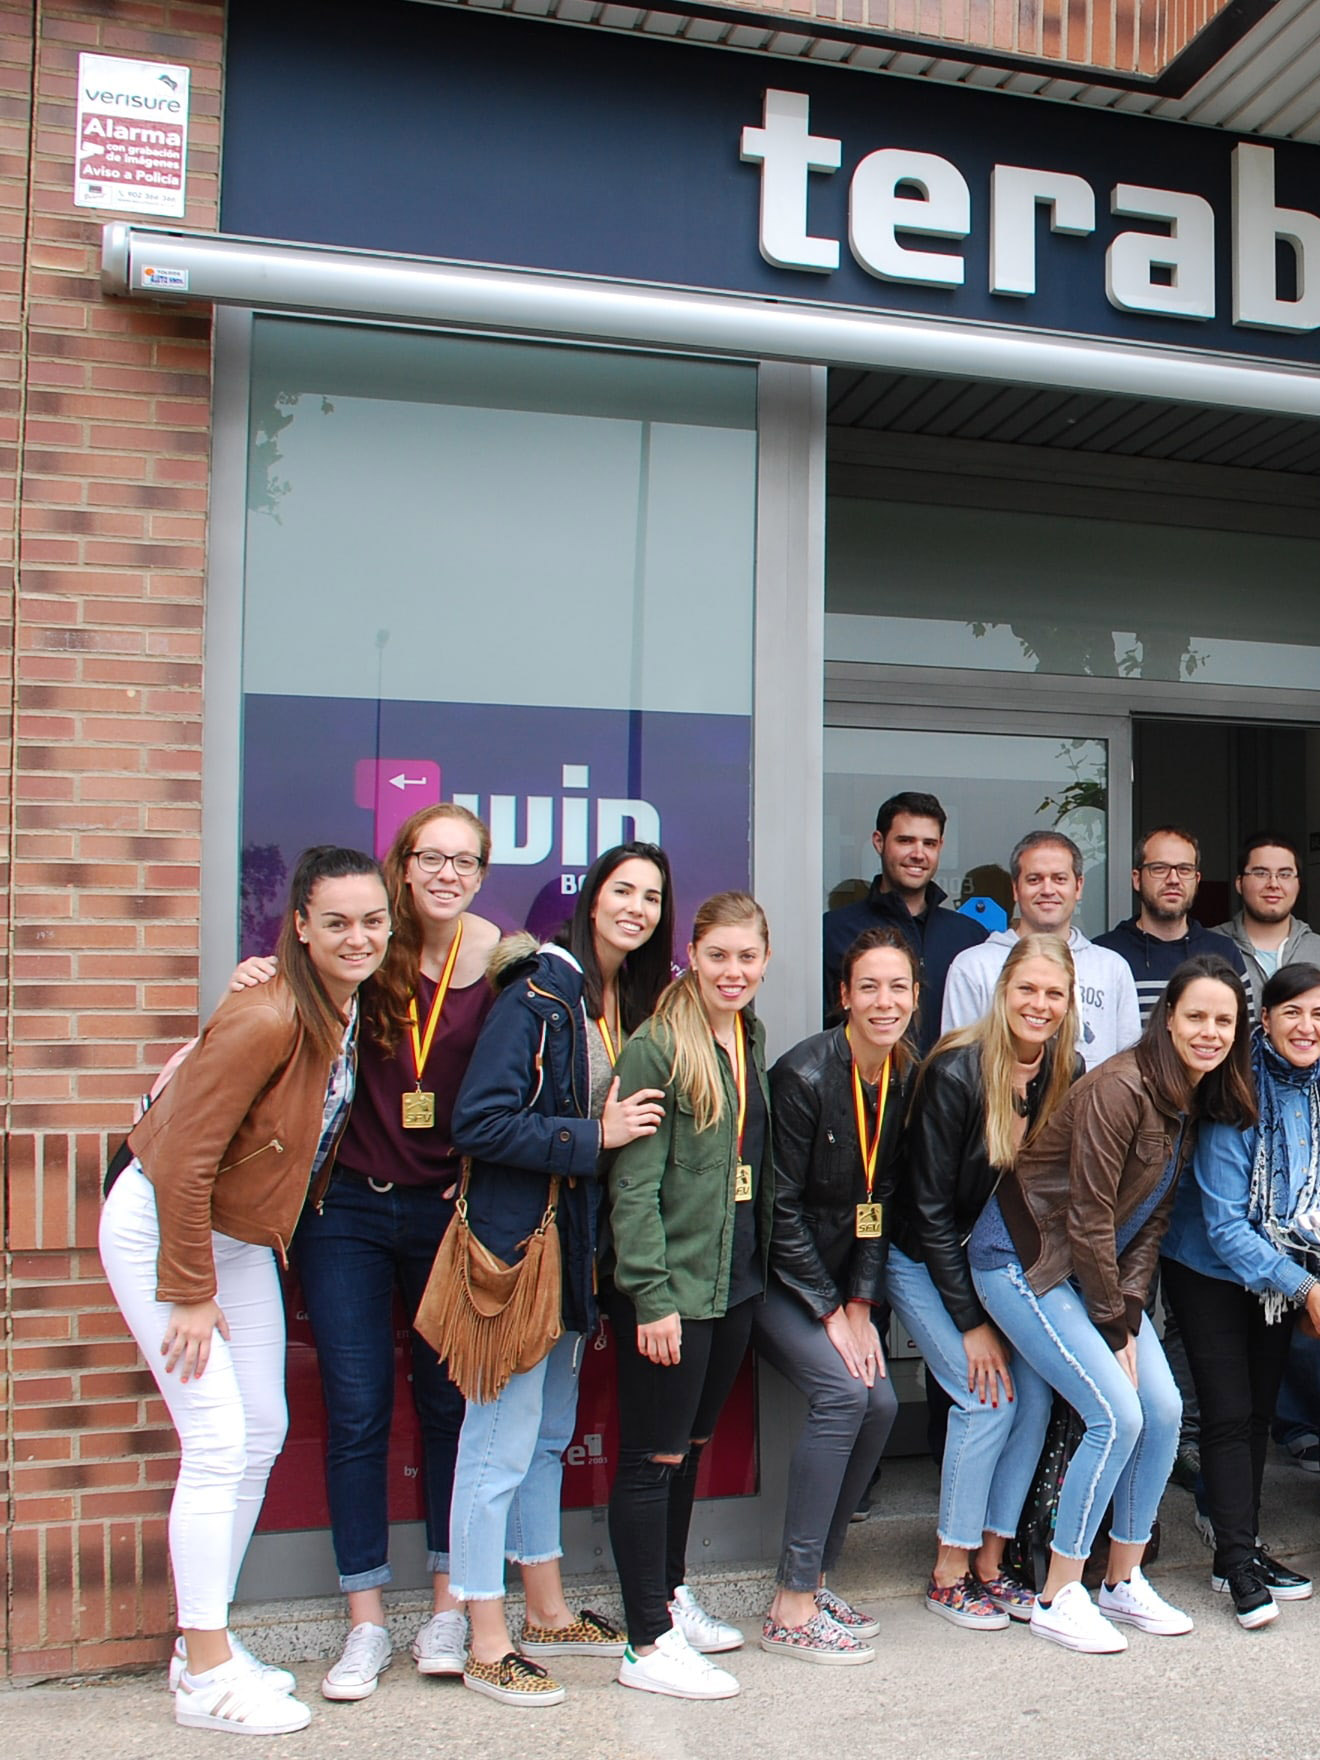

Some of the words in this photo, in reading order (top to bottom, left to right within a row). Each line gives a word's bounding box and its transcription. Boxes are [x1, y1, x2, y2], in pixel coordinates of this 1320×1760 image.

[85, 88, 181, 113] verisure
[83, 117, 181, 147] Alarma
[105, 143, 126, 152] con
[127, 146, 180, 159] grabación
[105, 151, 122, 162] de
[124, 153, 180, 169] imágenes
[82, 163, 120, 178] Aviso
[123, 171, 132, 179] a
[135, 169, 180, 185] Policía
[588, 1456, 608, 1465] 2003
[403, 1465, 418, 1479] by
